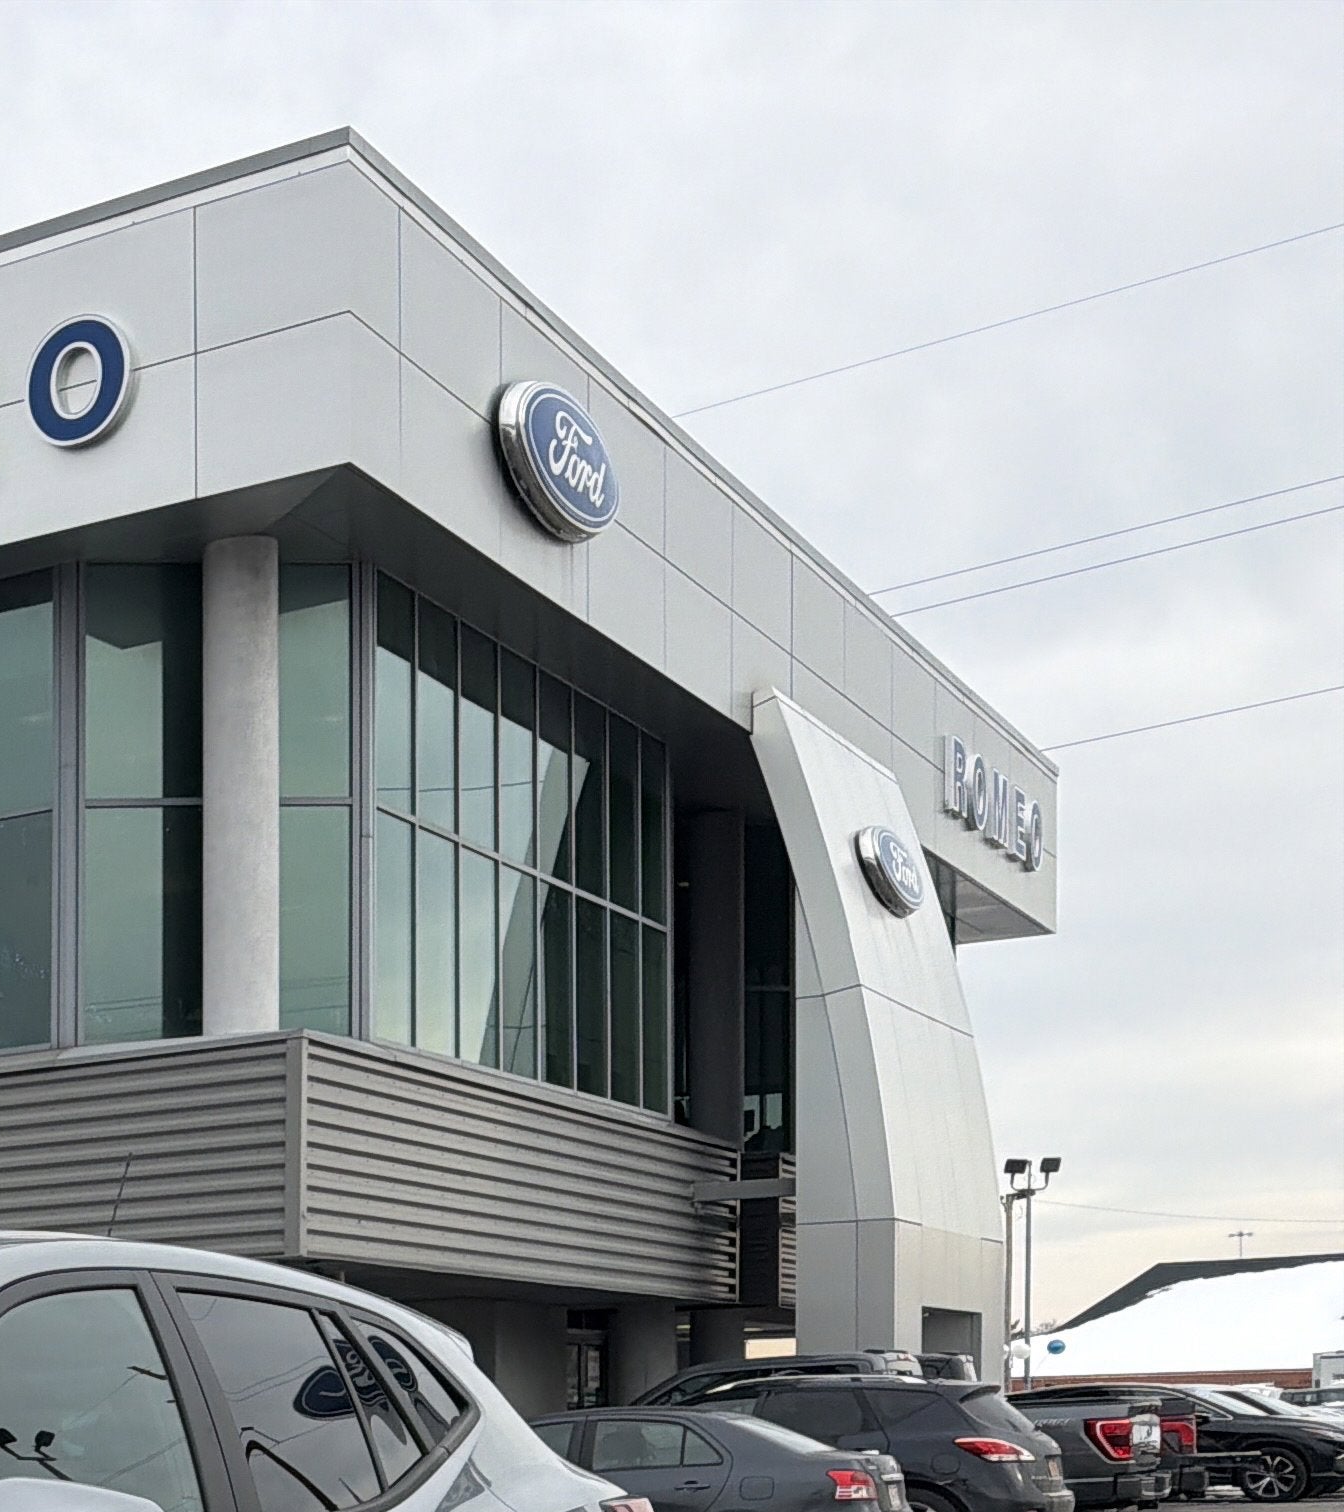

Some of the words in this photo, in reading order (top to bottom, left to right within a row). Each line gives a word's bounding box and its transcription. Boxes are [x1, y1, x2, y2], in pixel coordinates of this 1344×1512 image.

[548, 410, 607, 508] Ford
[945, 735, 1044, 872] ROMEO
[889, 841, 920, 895] Ford
